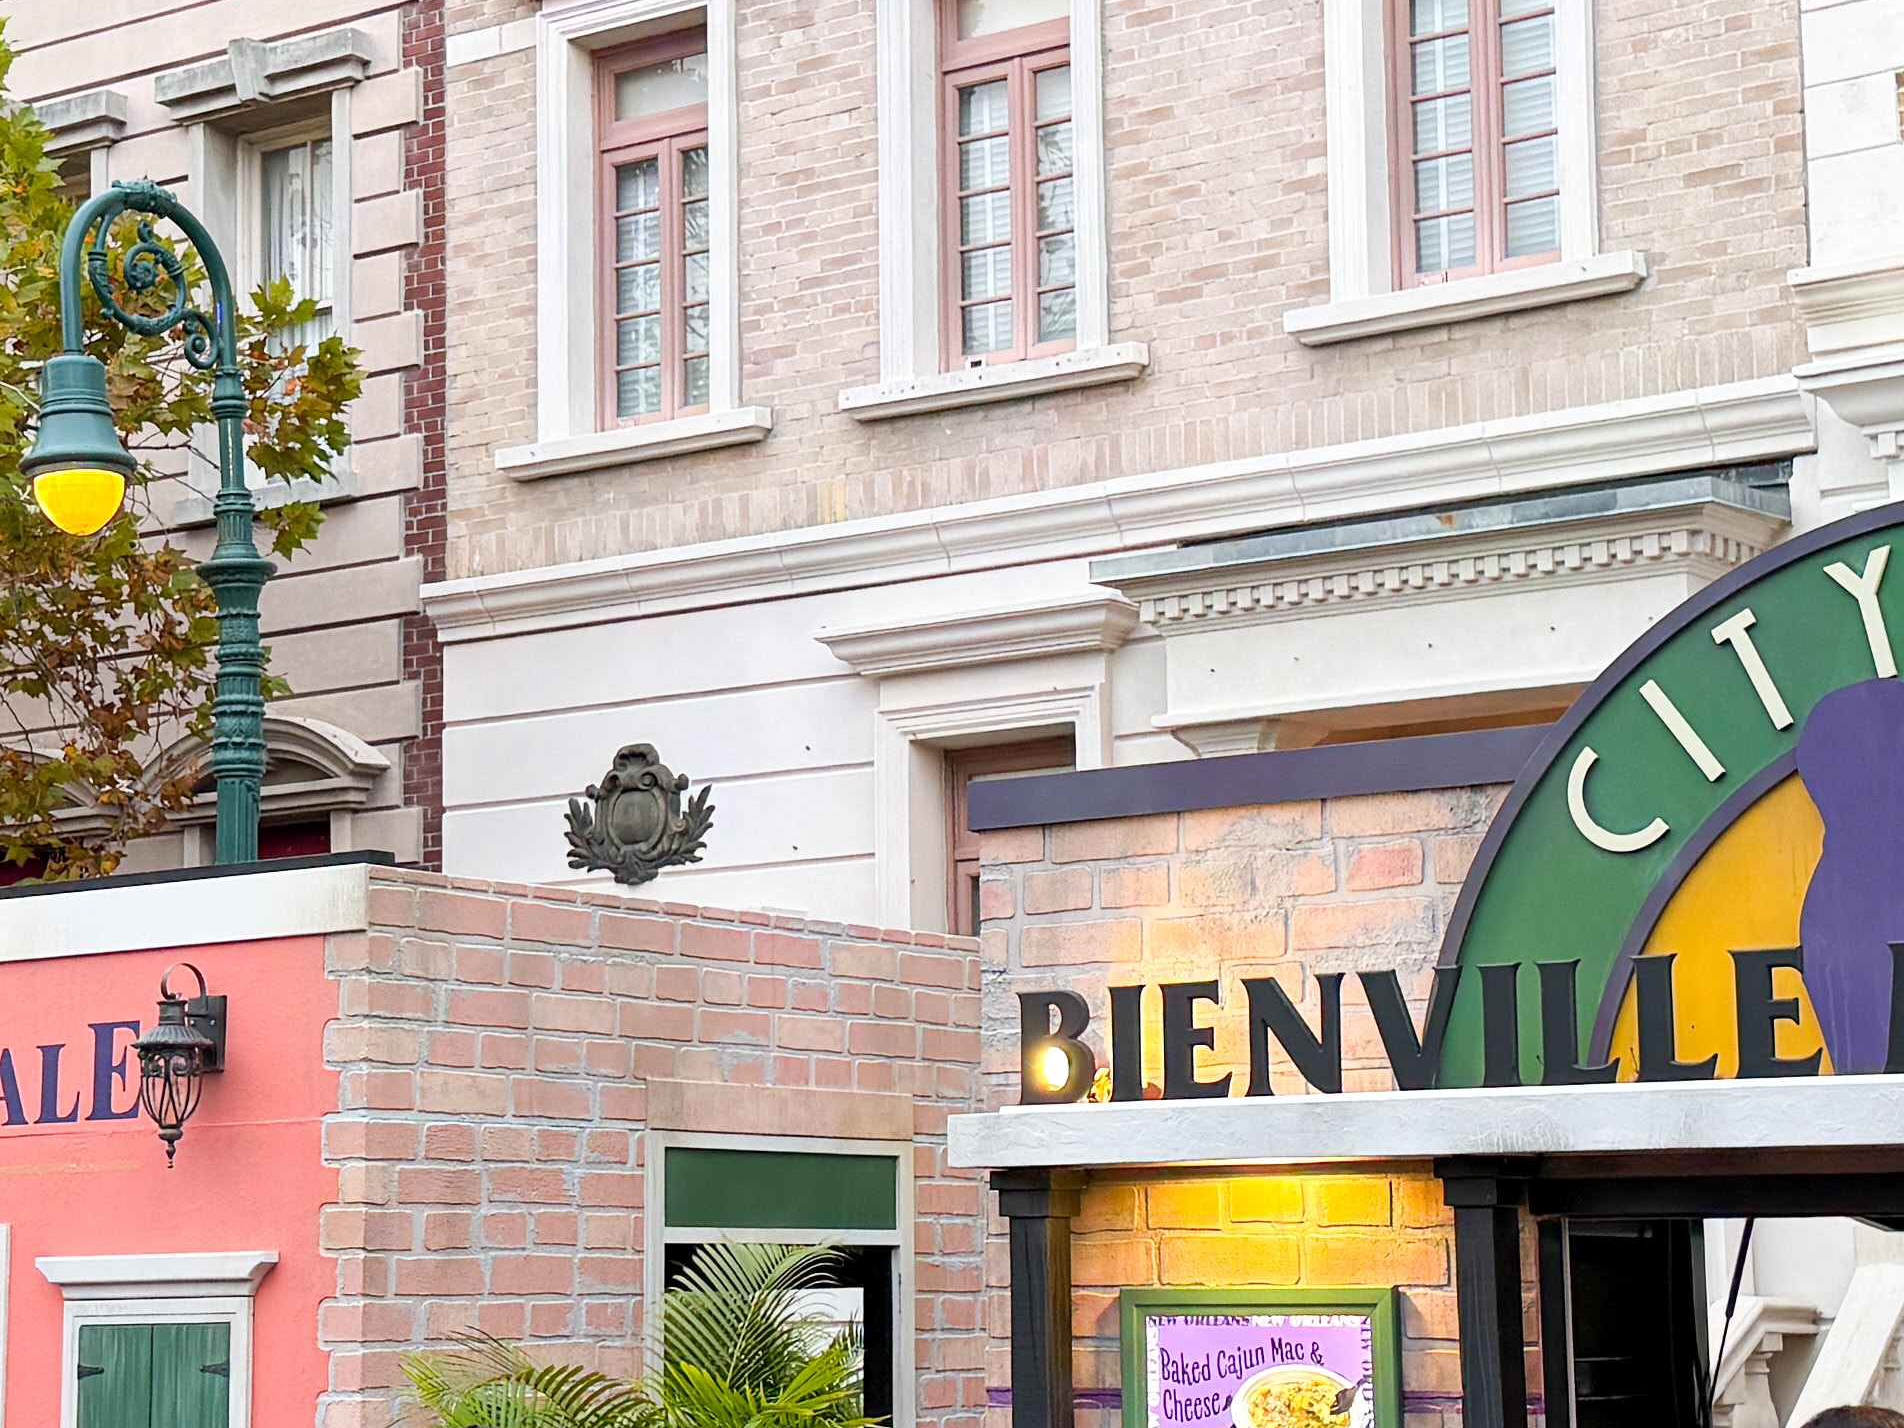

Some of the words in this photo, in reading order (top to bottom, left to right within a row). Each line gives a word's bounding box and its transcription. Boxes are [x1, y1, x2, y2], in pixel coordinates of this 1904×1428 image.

[1567, 544, 1899, 853] CITY
[1017, 944, 1824, 1105] BIENVILLE
[1160, 1347, 1211, 1386] Baked
[1216, 1346, 1265, 1380] Cajun
[1270, 1337, 1305, 1363] Mac
[1309, 1341, 1325, 1366] &
[1162, 1388, 1221, 1423] Cheese
